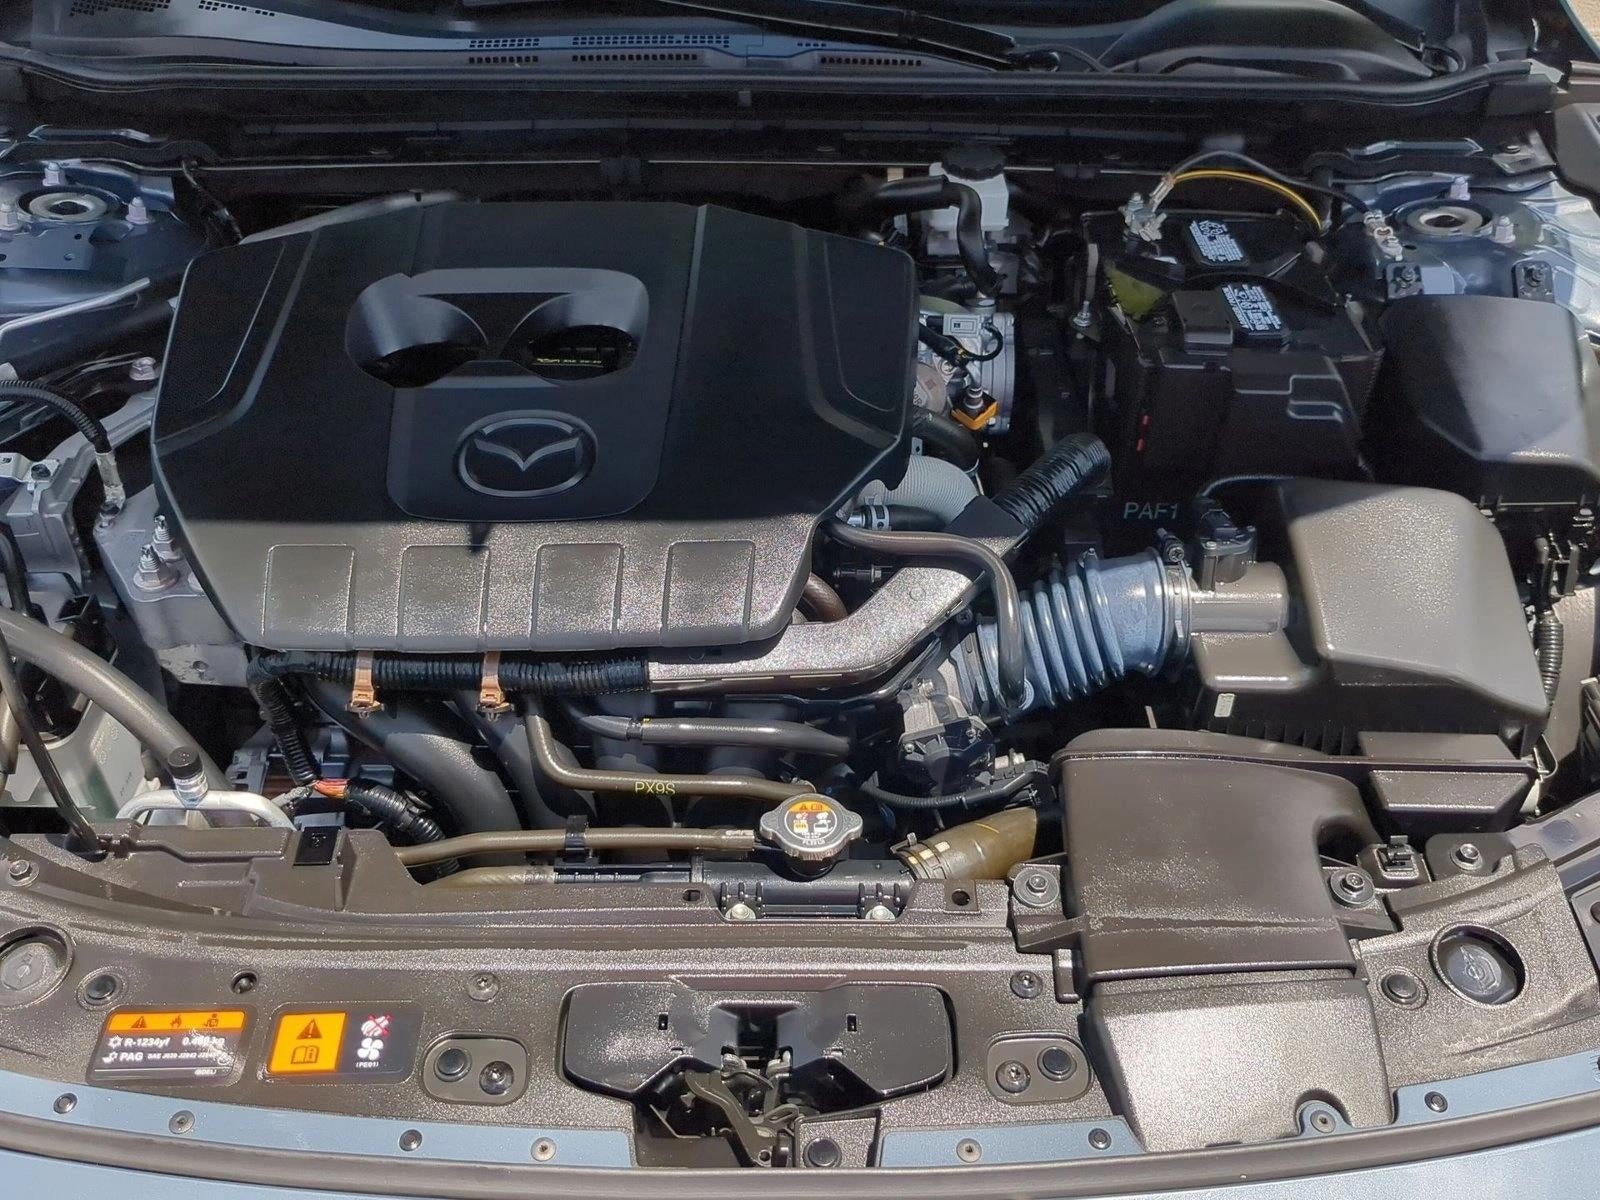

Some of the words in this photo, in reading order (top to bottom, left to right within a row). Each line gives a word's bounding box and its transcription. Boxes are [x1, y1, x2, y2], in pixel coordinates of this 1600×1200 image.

[1123, 502, 1178, 519] PAF1
[635, 781, 676, 795] PX9S
[124, 1036, 170, 1048] R-1234yf
[119, 1052, 144, 1062] PAG
